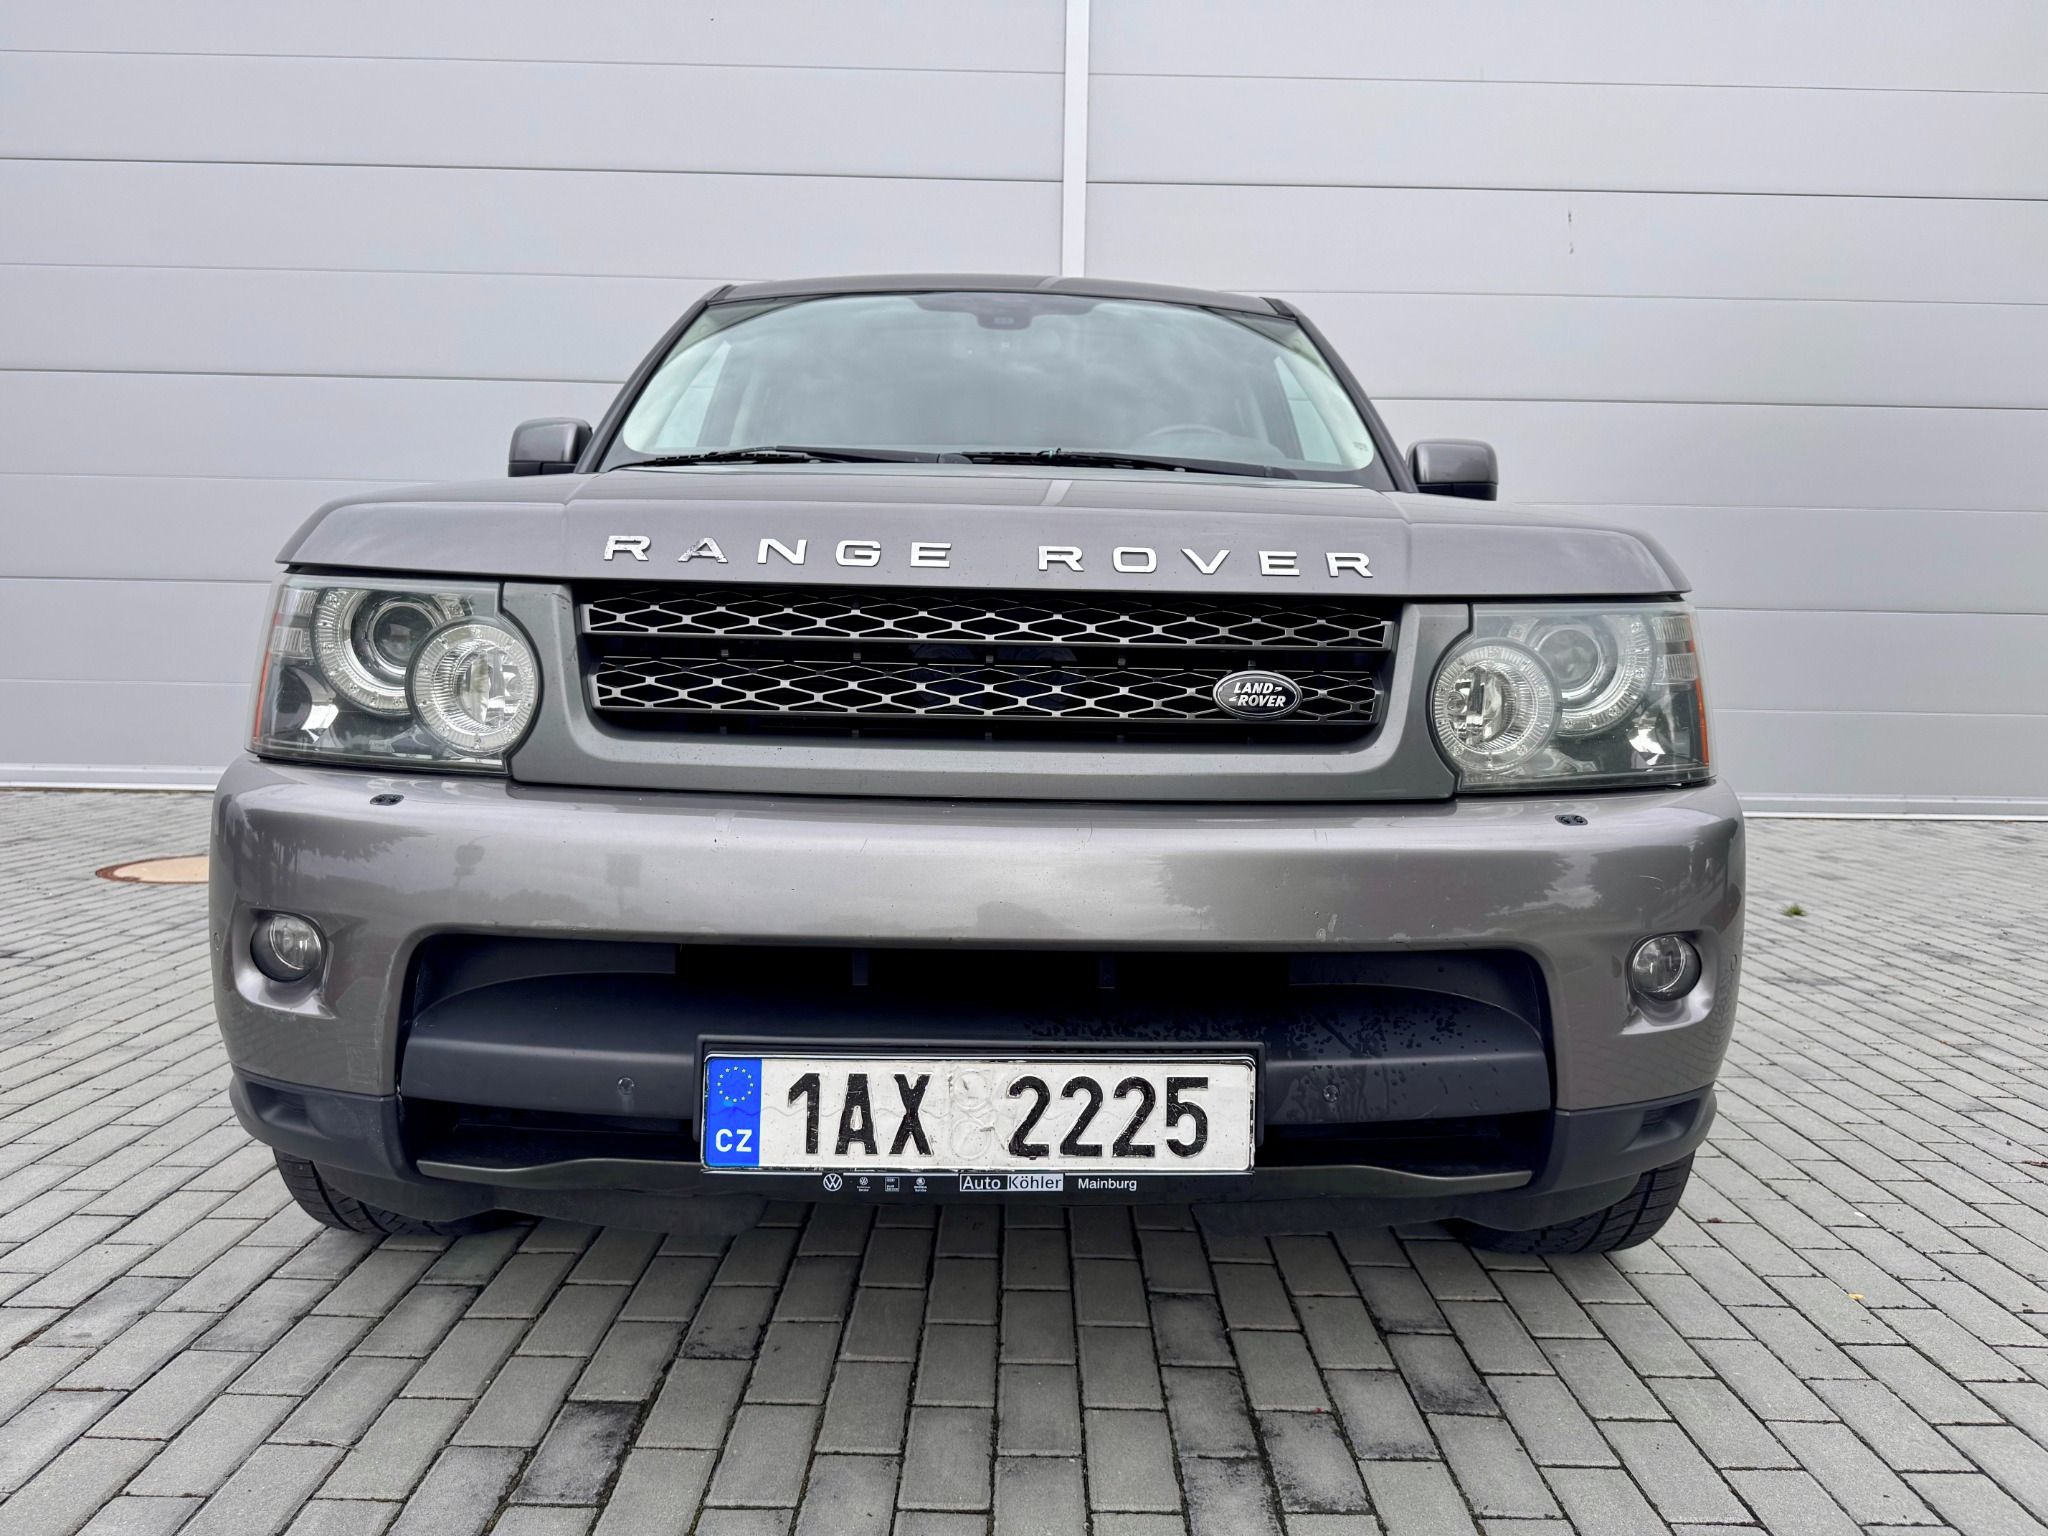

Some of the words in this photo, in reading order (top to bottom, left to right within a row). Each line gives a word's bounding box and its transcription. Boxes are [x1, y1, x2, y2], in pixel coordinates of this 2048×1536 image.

[603, 535, 951, 568] RANGE
[1038, 545, 1373, 578] ROVER
[1233, 682, 1274, 694] LAND
[1237, 694, 1286, 707] ROVER
[788, 1072, 935, 1156] 1AX
[1007, 1075, 1209, 1158] 2225
[715, 1129, 752, 1153] CZ
[962, 1175, 1001, 1190] Auto
[1008, 1175, 1062, 1190] Köhler
[1078, 1178, 1137, 1191] Mainburg
